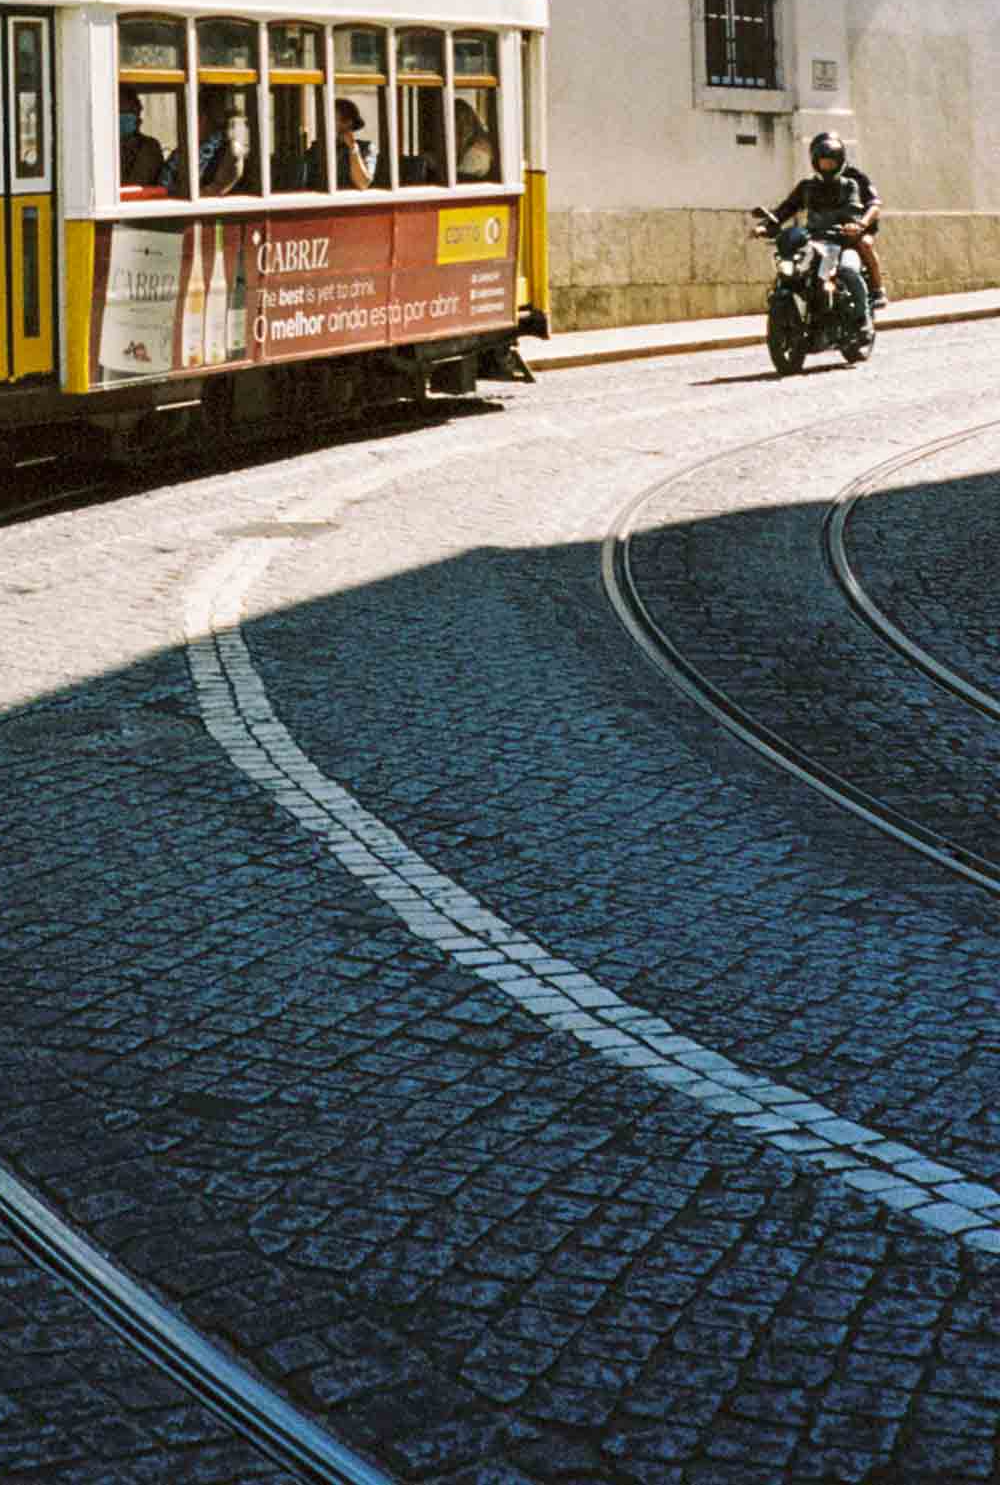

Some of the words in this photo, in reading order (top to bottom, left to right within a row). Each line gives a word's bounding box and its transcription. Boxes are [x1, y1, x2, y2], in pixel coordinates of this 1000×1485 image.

[257, 237, 329, 275] CABRIZ
[279, 284, 305, 307] best
[254, 315, 268, 343] O
[271, 311, 325, 341] melhor
[327, 304, 368, 333] ainda
[403, 299, 427, 331] por
